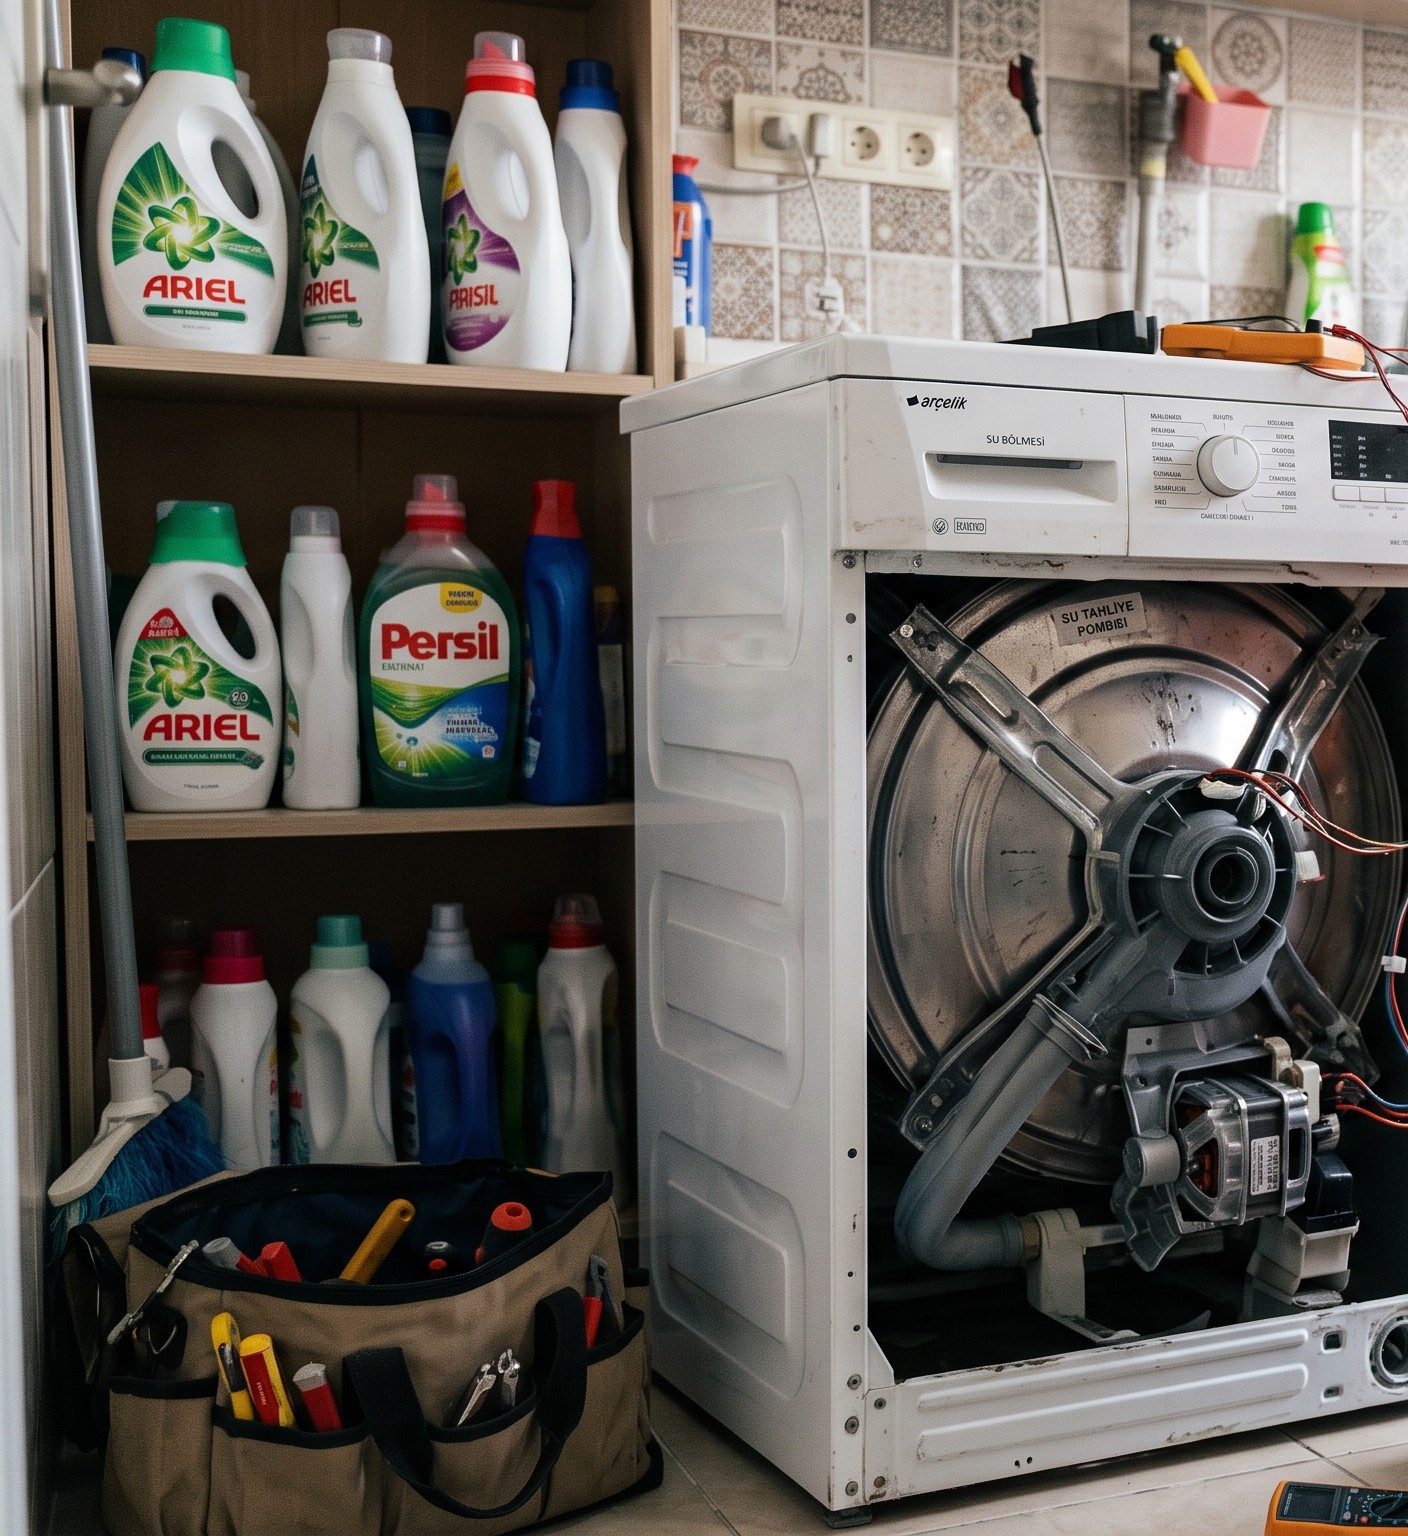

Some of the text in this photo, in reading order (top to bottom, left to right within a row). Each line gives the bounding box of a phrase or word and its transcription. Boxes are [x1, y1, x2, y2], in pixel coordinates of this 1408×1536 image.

[143, 275, 246, 305] ARIEL
[303, 279, 357, 308] ARIEL
[921, 397, 967, 411] arçelik
[986, 434, 999, 444] SU
[1061, 600, 1135, 624] SU TAHLİYE
[381, 621, 499, 660] Persil
[143, 714, 260, 741] ARIEL
